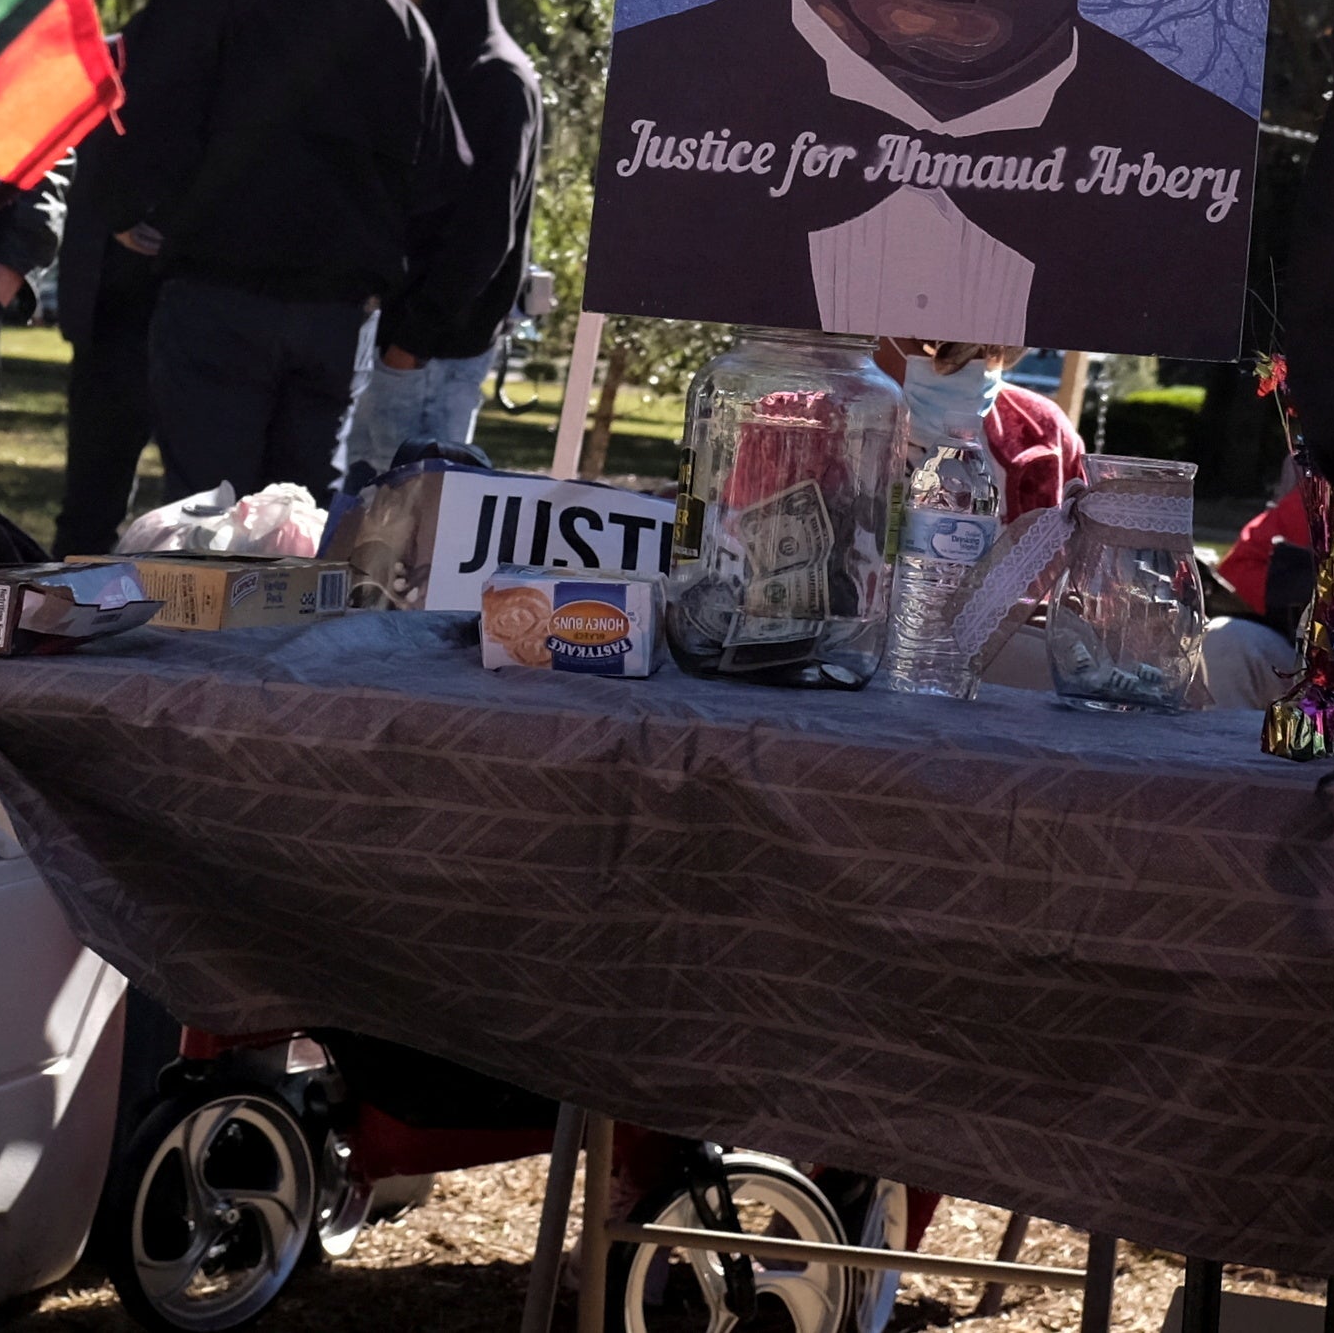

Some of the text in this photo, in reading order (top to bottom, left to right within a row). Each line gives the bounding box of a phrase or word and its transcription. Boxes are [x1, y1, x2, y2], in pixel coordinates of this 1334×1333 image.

[617, 119, 1241, 223] Justice for Ahmaud Arbery
[553, 616, 624, 632] HONEY BUNS
[547, 637, 630, 658] TASTYKAKE
